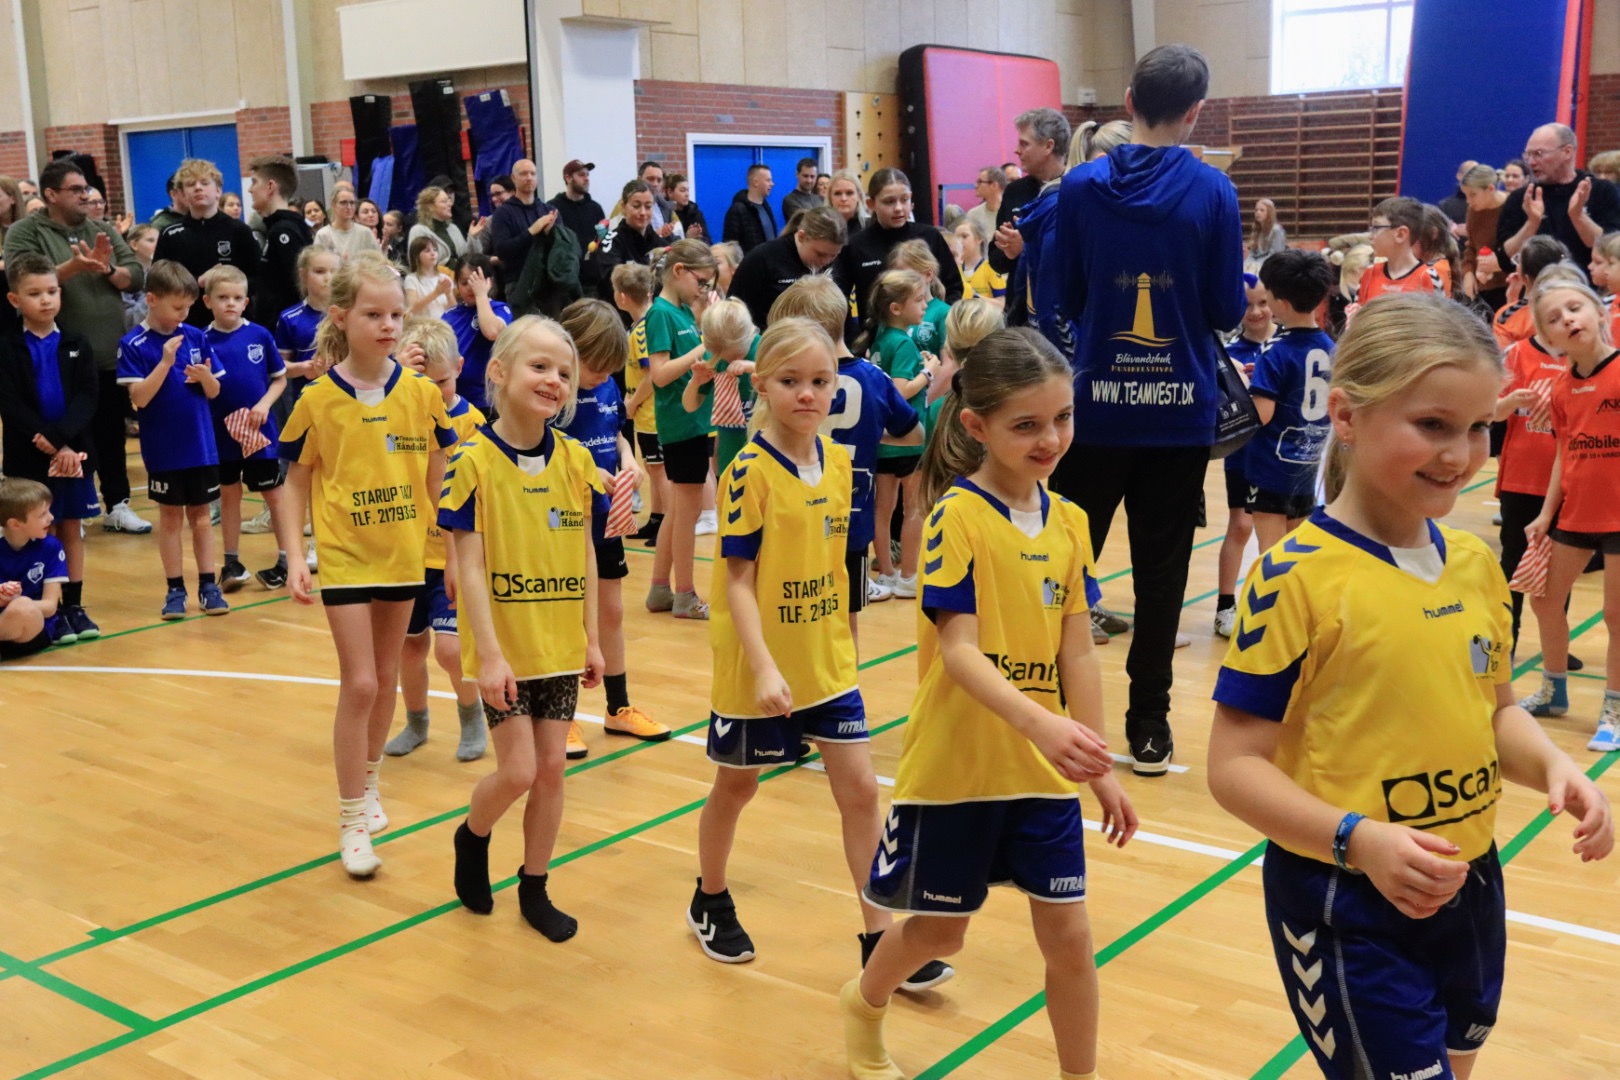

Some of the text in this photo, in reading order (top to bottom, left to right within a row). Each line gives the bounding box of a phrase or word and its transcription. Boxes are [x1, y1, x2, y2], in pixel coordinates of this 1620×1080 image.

[1301, 348, 1331, 421] 6
[352, 486, 398, 507] STARUP
[523, 486, 549, 494] hummel
[350, 510, 376, 527] TLF.
[1020, 551, 1049, 561] hummel
[778, 605, 807, 623] TLF.
[1422, 599, 1465, 620] hummel
[754, 747, 785, 757] hummel
[1050, 876, 1086, 891] VITRA
[923, 890, 962, 904] hummel
[1390, 1058, 1444, 1080] hummel
